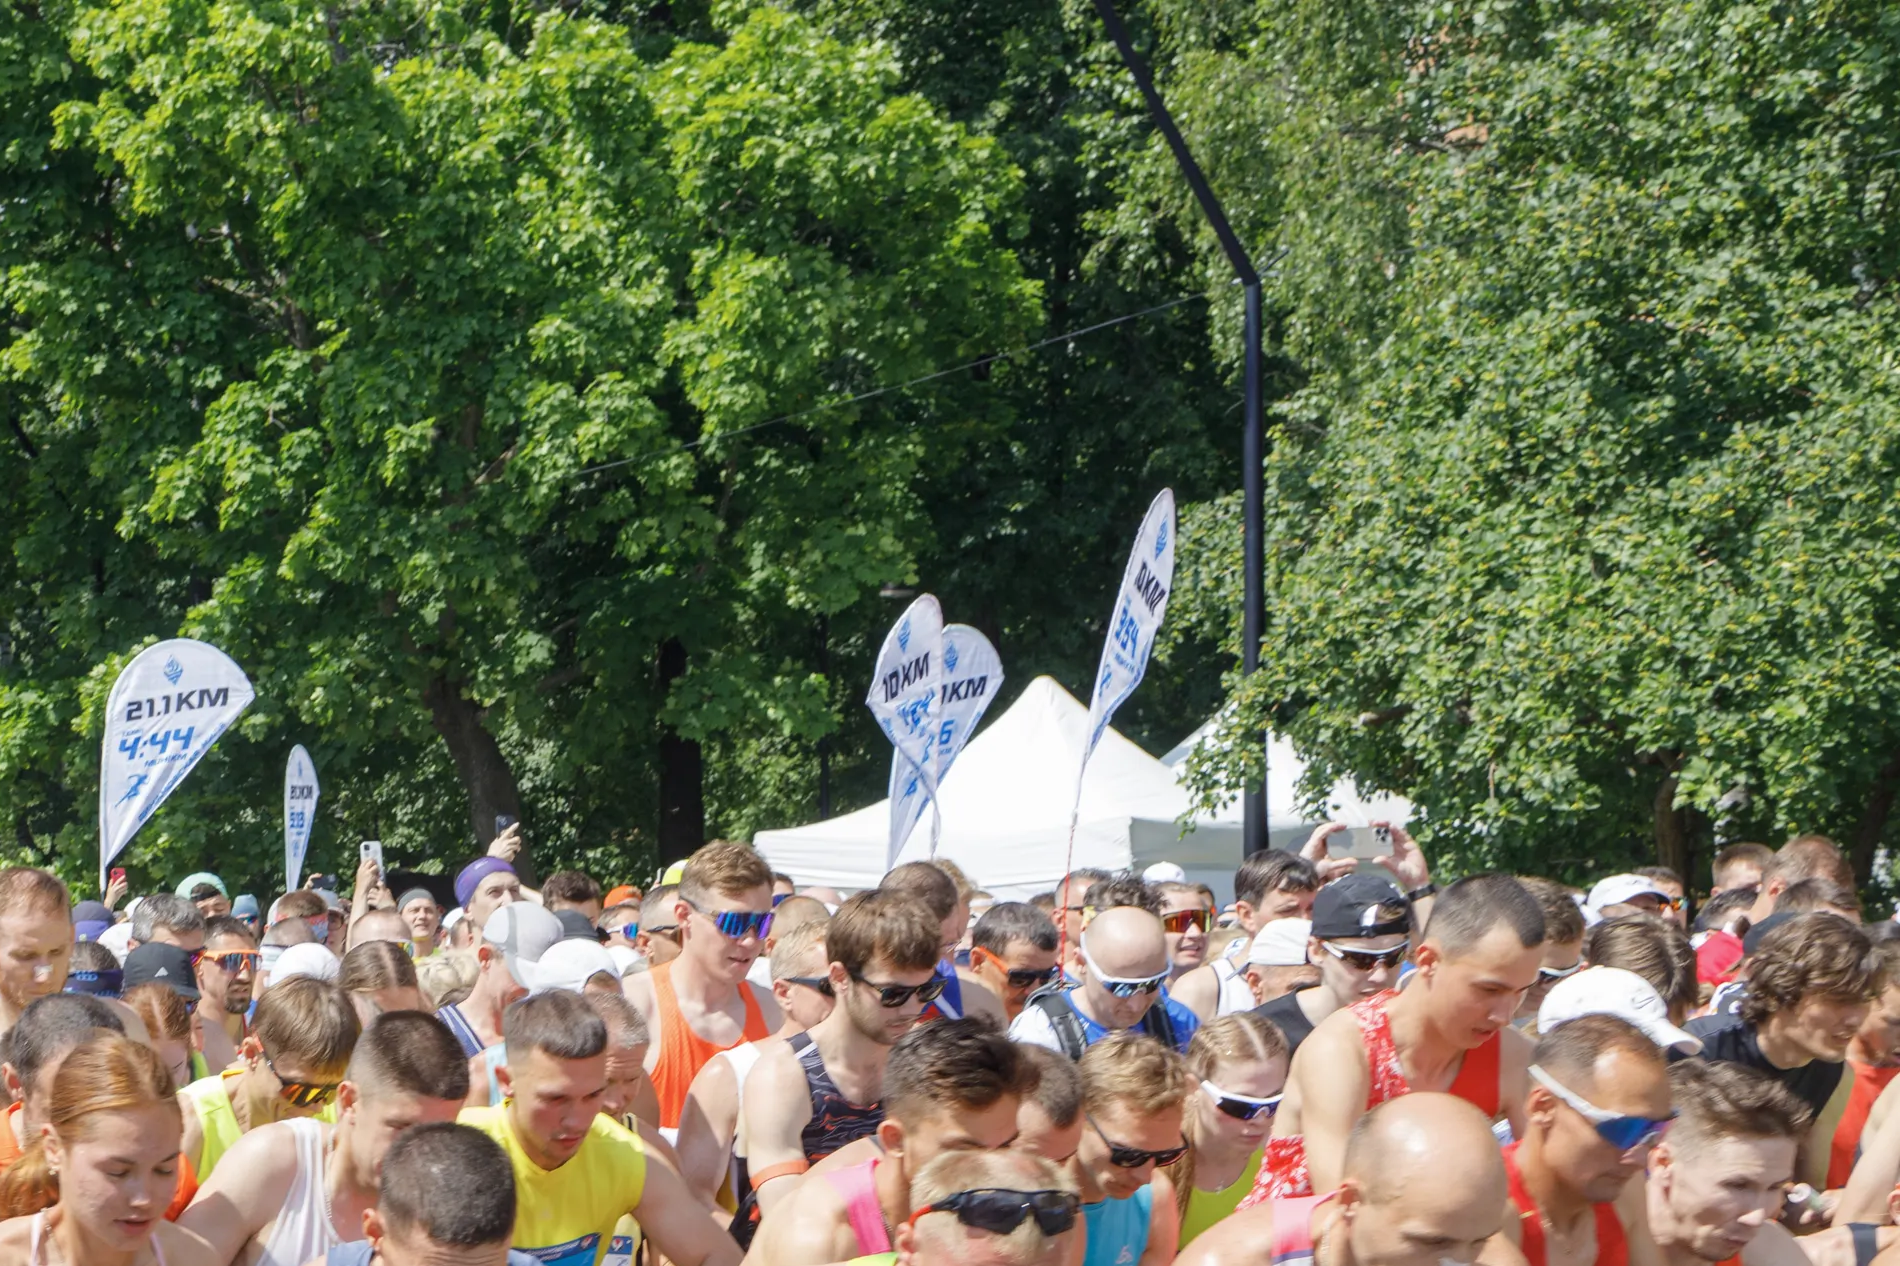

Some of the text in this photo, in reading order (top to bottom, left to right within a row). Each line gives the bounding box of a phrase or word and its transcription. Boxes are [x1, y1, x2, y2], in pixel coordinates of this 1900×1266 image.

[883, 651, 930, 703] 10KM
[126, 687, 229, 722] 21.1KM
[118, 726, 195, 760] 4:44
